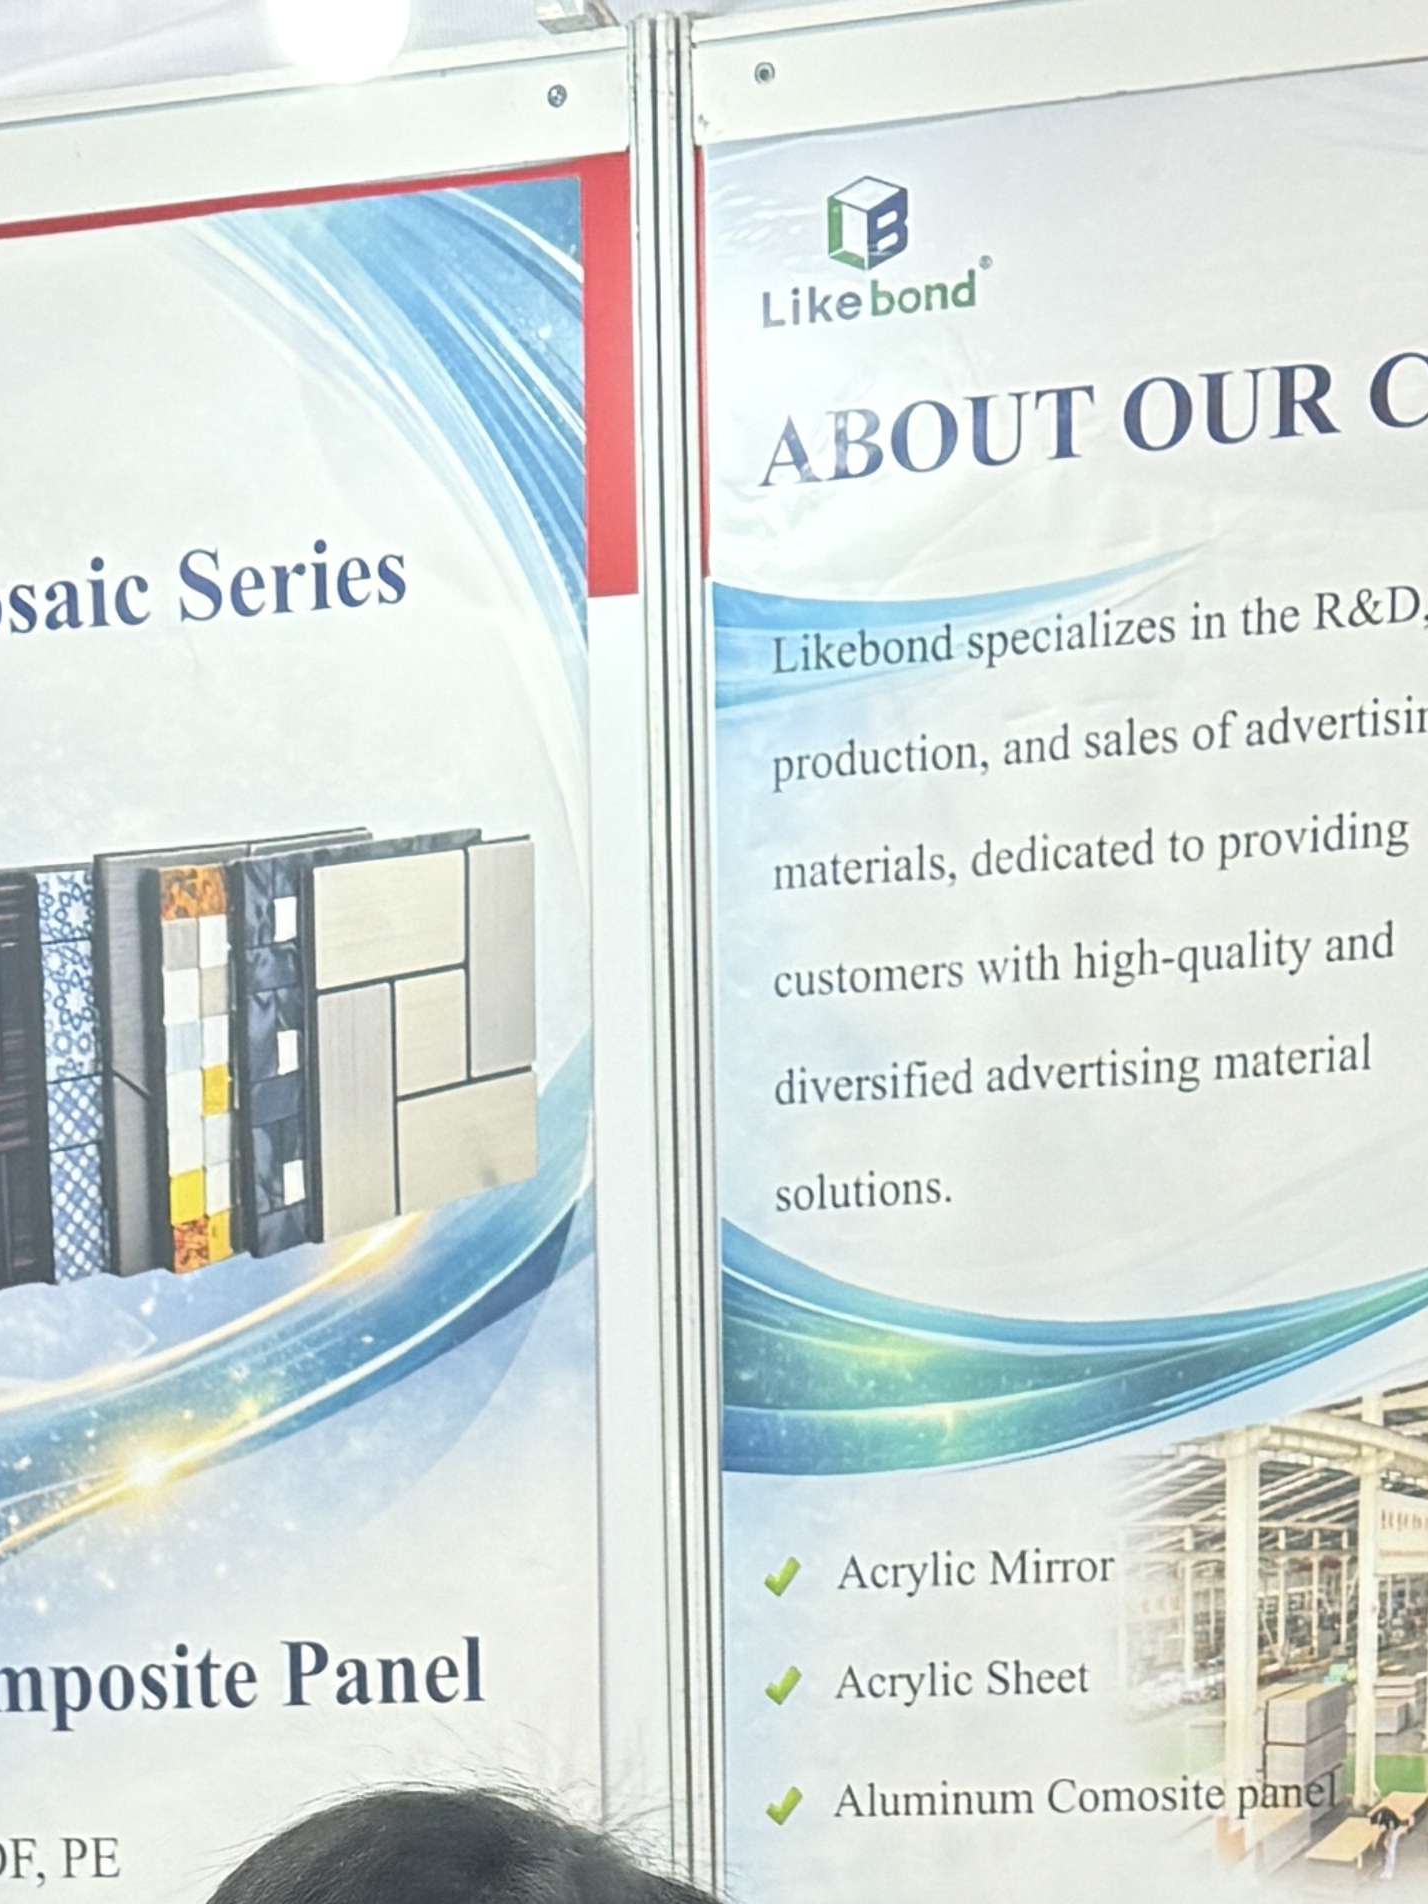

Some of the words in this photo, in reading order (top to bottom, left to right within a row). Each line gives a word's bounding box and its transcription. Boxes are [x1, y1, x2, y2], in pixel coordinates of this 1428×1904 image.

[759, 384, 1095, 488] ABOUT
[1123, 363, 1341, 452] OUR
[179, 538, 407, 622] Series
[773, 622, 955, 674] Likebond
[967, 607, 1176, 669] specializes
[1191, 601, 1227, 641] in
[1241, 596, 1300, 637] the
[773, 733, 989, 794] production,
[1003, 722, 1070, 766] and
[1084, 717, 1179, 759] sales
[1192, 709, 1239, 751] of
[774, 843, 957, 891] materials,
[971, 826, 1154, 877] dedicated
[1168, 831, 1205, 864] to
[1218, 811, 1409, 871] providing
[773, 961, 964, 998] customers
[977, 942, 1061, 984] with
[1074, 928, 1312, 988] high-quality
[1325, 919, 1394, 963] and
[774, 1057, 973, 1106] diversified
[986, 1045, 1200, 1093] advertising
[1214, 1031, 1371, 1081] material
[775, 1170, 952, 1213] solutions.
[837, 1549, 976, 1598] Acrylic
[990, 1547, 1116, 1586] Mirror
[281, 1636, 485, 1707] Panel
[835, 1660, 973, 1708] Acrylic
[987, 1659, 1089, 1696] Sheet
[833, 1779, 1034, 1818] Aluminum
[1047, 1774, 1226, 1814] Comosite
[1237, 1771, 1339, 1821] panel
[61, 1837, 120, 1879] PE
